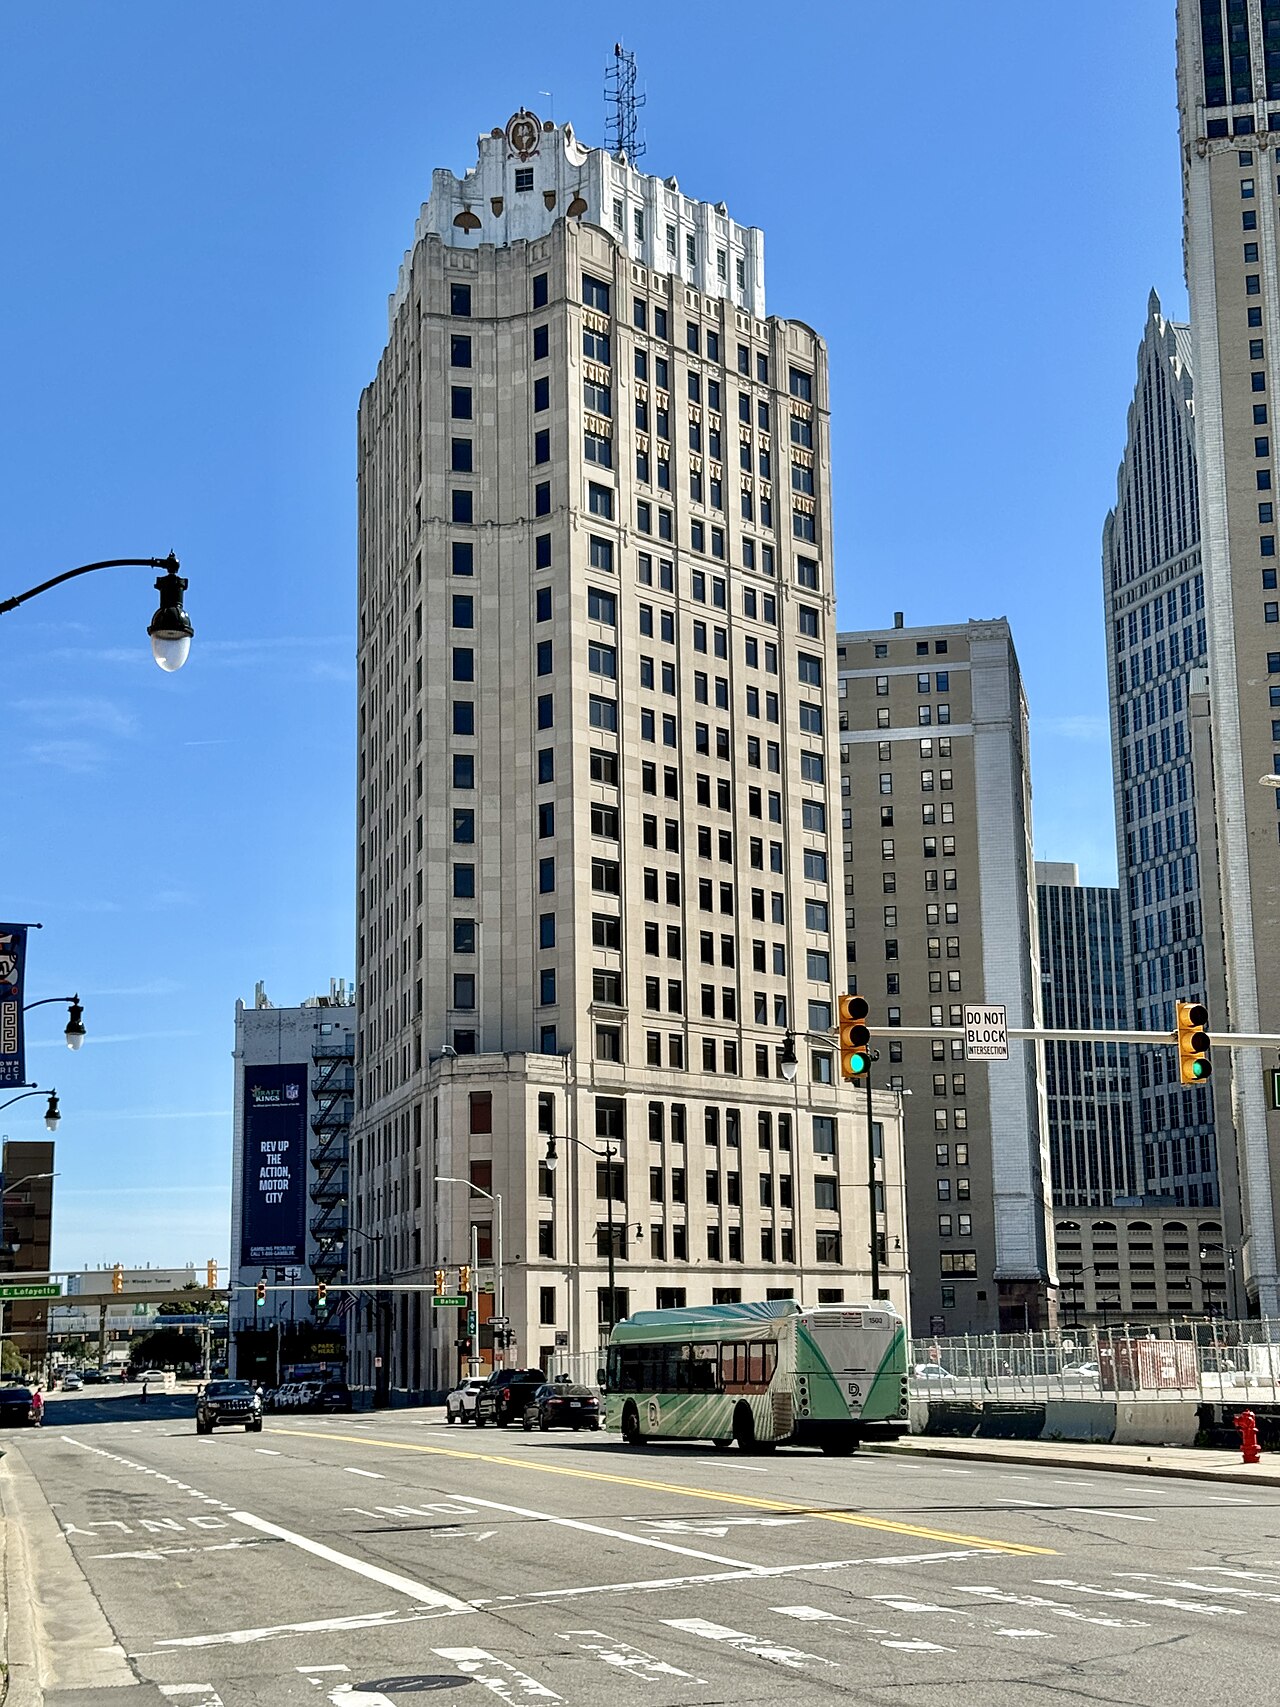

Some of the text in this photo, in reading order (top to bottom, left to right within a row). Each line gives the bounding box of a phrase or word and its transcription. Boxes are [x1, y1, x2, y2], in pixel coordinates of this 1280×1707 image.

[967, 1012, 1005, 1025] DO NOT
[968, 1030, 1006, 1042] BLOCK
[968, 1046, 1006, 1055] INTERSECTION
[261, 1141, 289, 1152] REV UP
[266, 1154, 281, 1164] THE
[260, 1166, 290, 1178] ACTION,
[260, 1179, 289, 1190] MOTOR
[266, 1192, 283, 1203] CITY
[56, 1516, 229, 1537] ONLY
